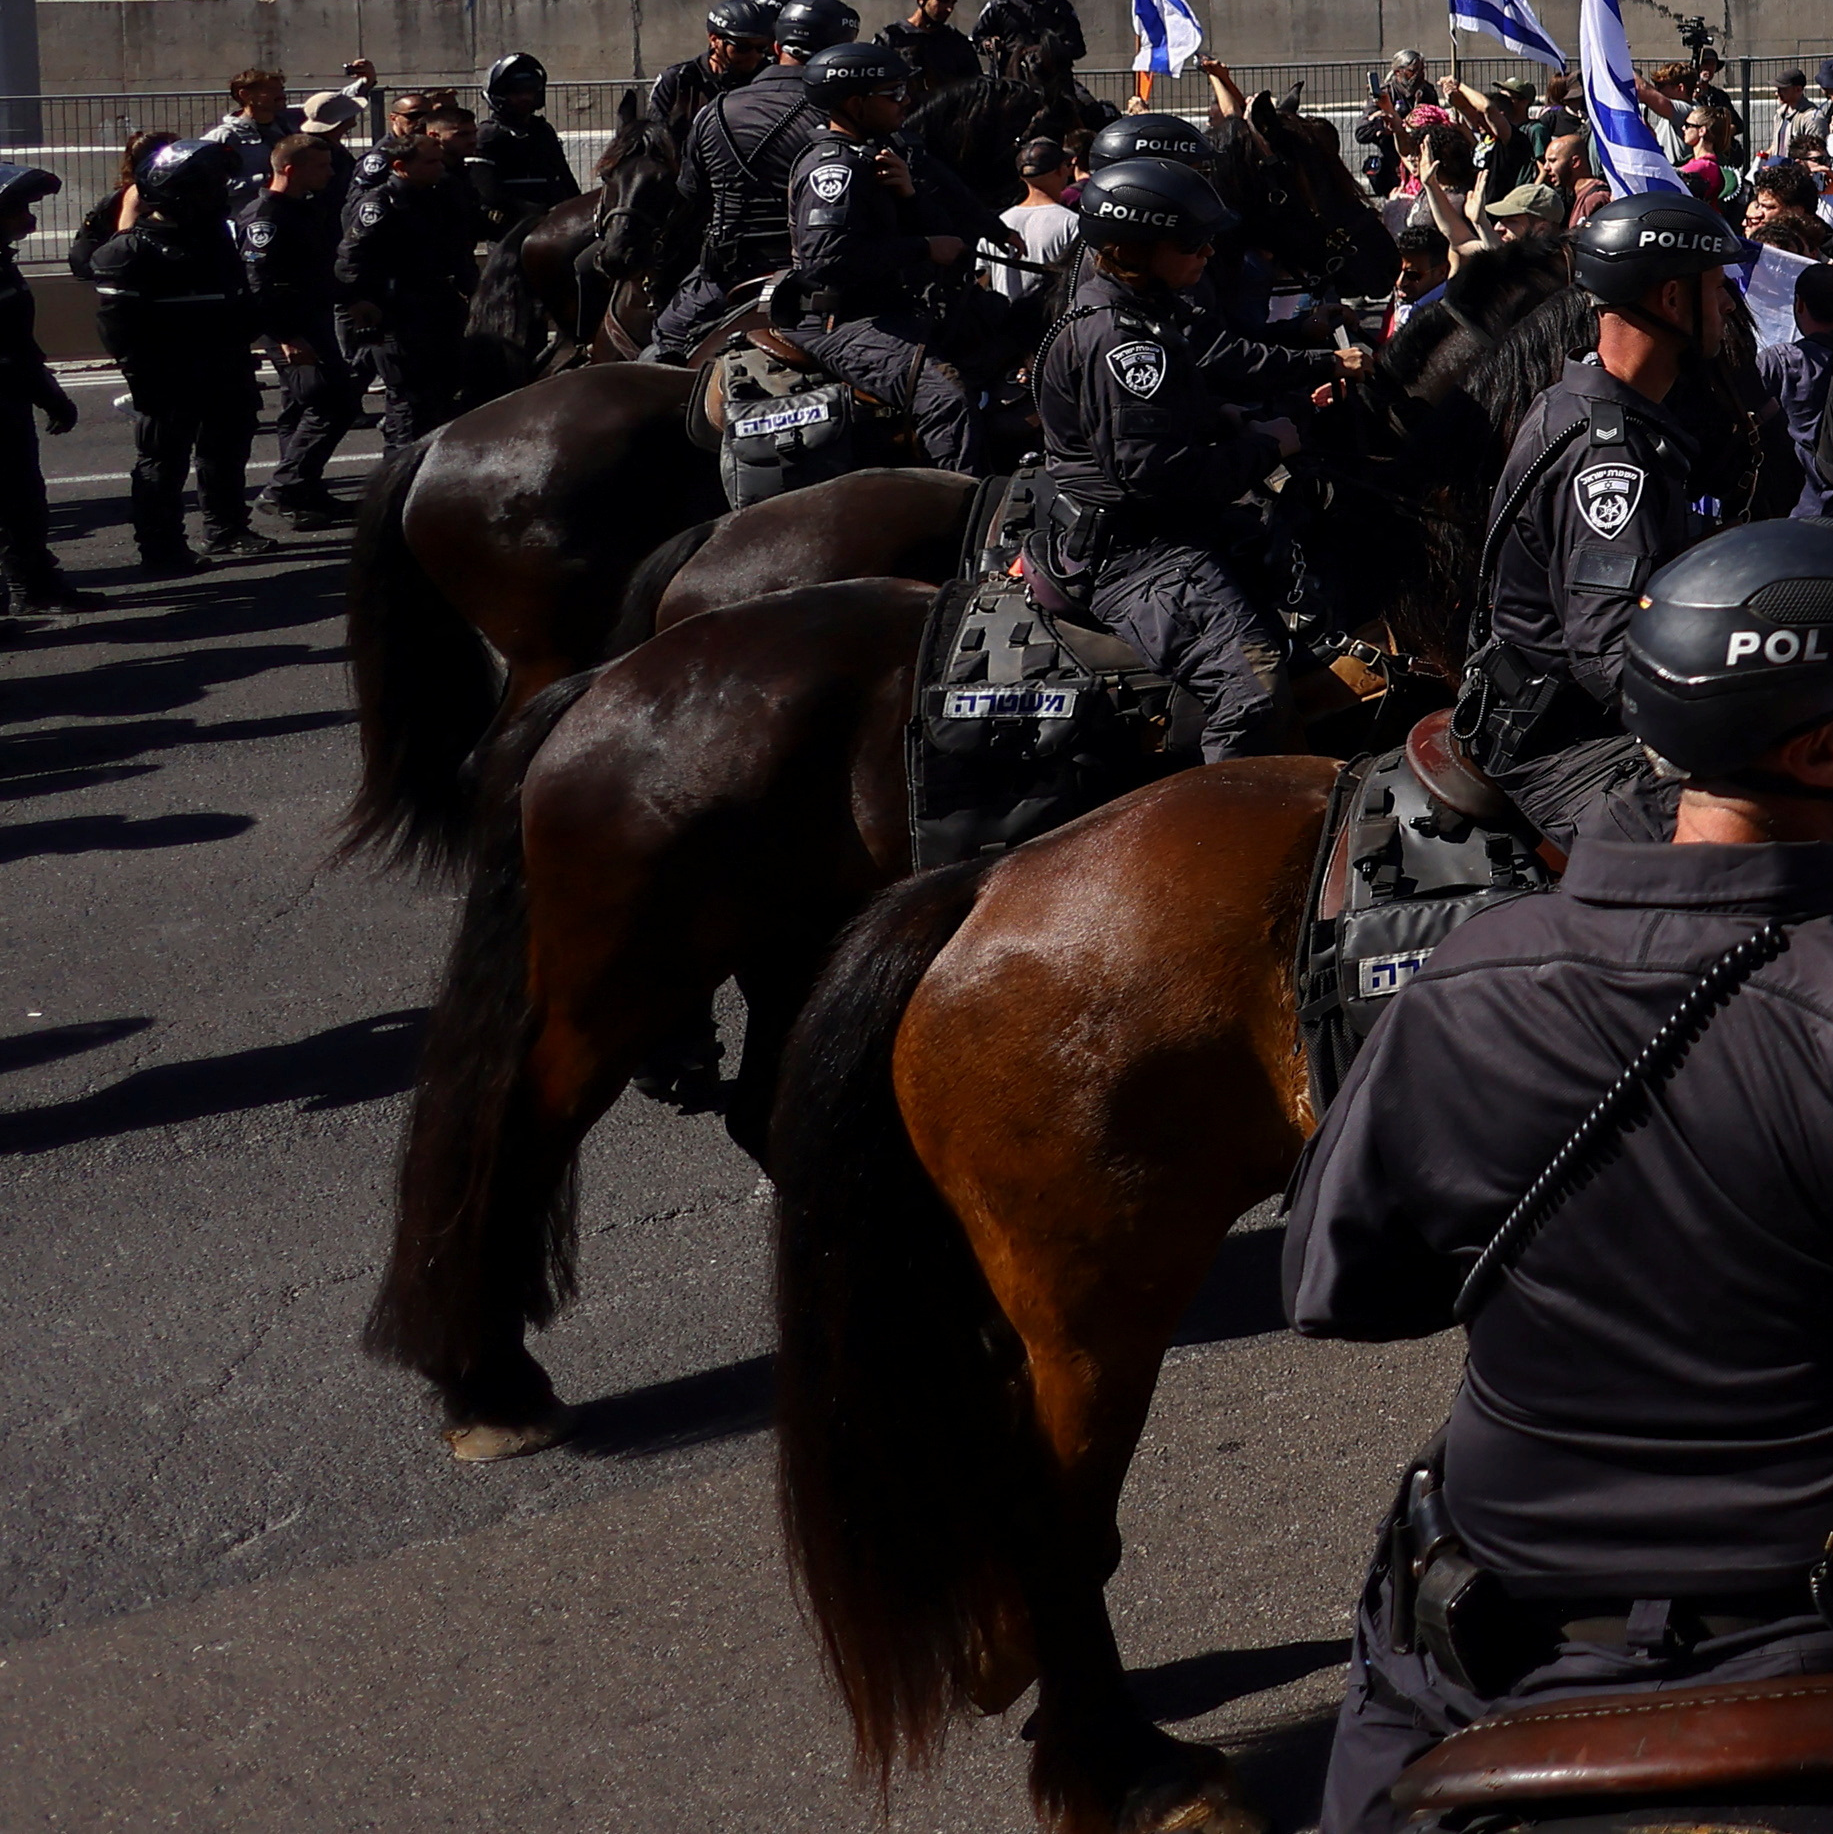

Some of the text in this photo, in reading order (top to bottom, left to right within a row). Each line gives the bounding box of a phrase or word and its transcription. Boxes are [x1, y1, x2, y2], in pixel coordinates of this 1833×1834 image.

[826, 67, 885, 79] POLICE
[1135, 139, 1197, 153] POLICE
[1099, 201, 1179, 227] POLICE
[1638, 230, 1723, 254] POLICE
[743, 407, 821, 434] משטרה
[1580, 469, 1638, 485] משטרת ישראל
[954, 694, 1066, 715] משטרה
